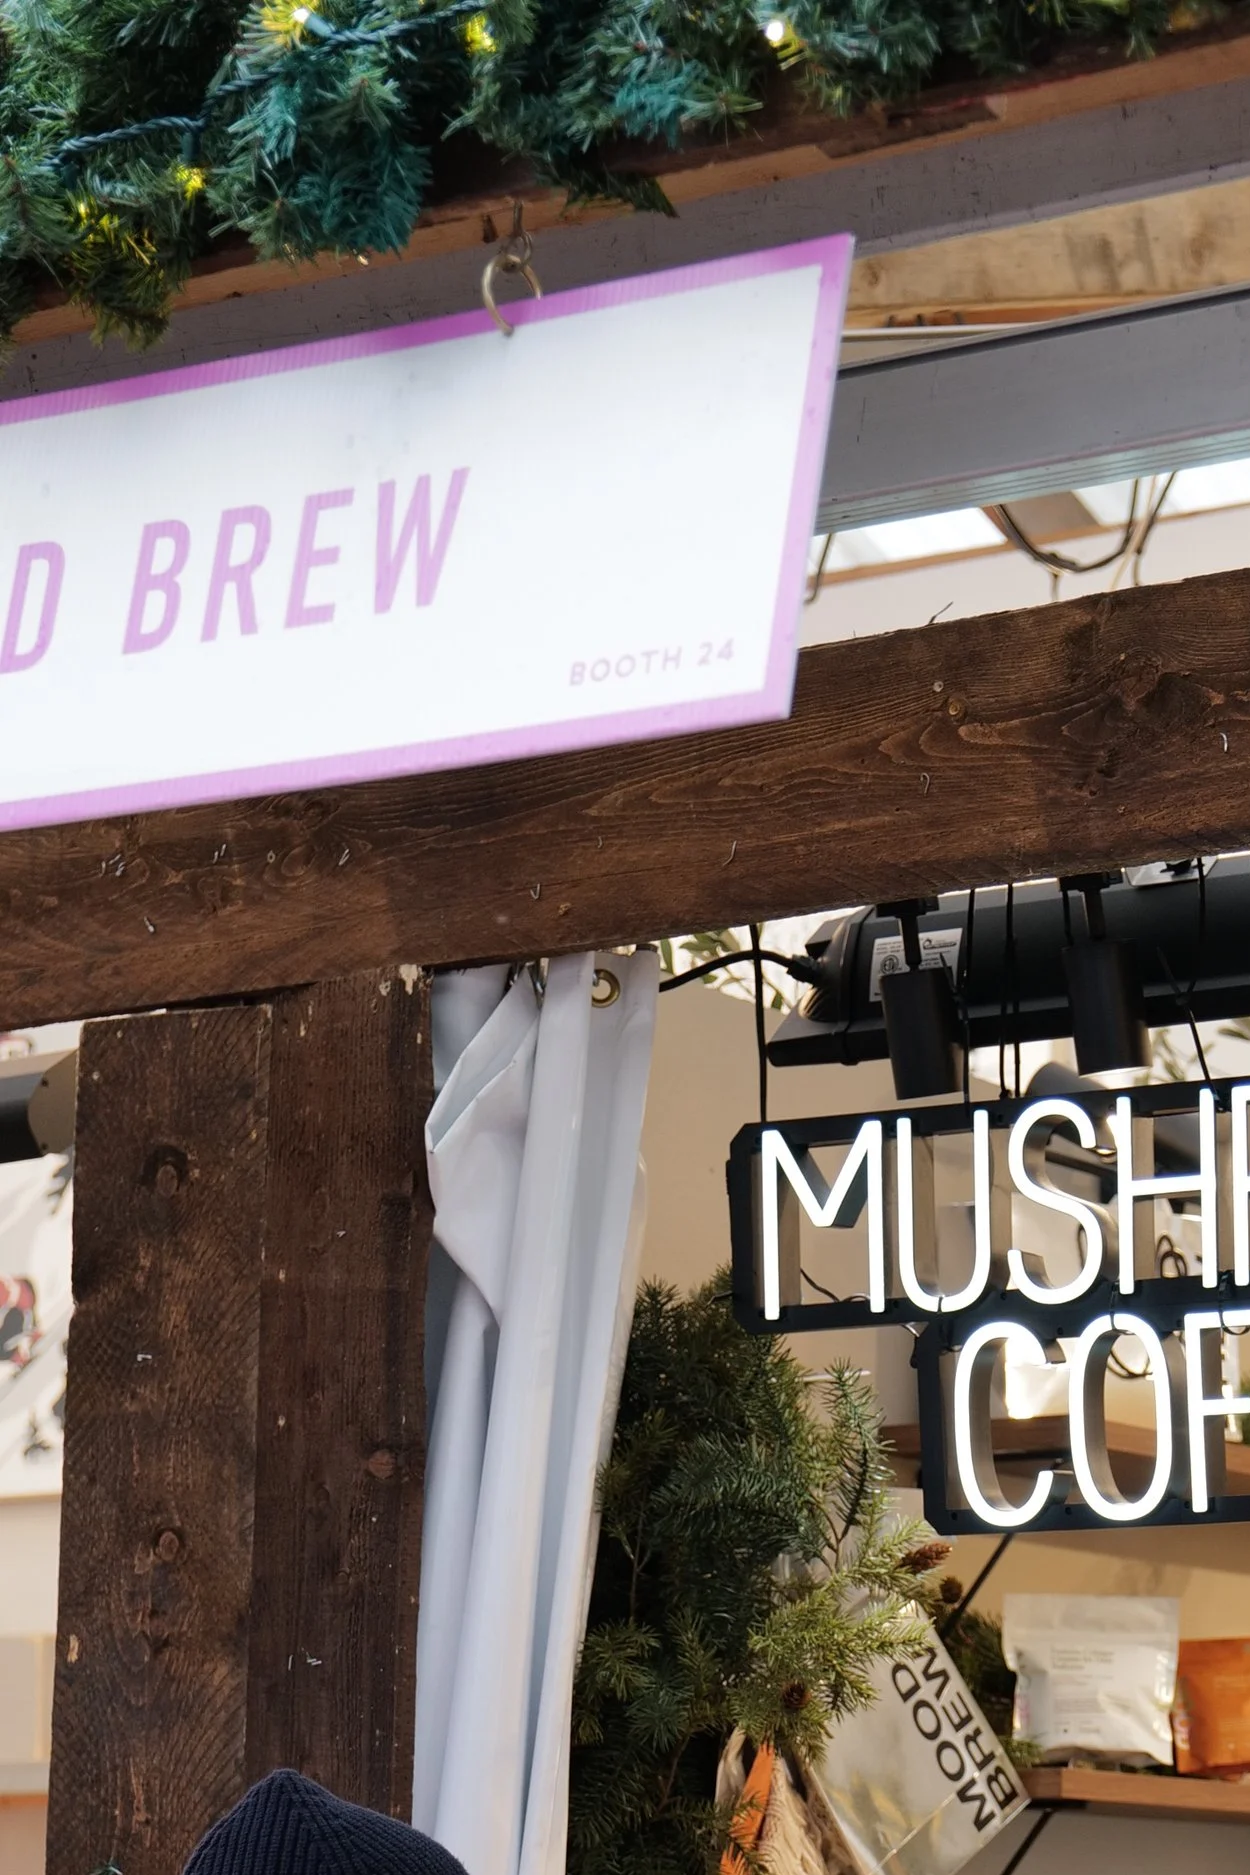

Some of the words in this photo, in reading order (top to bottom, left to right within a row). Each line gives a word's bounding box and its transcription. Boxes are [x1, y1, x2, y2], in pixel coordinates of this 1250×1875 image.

[122, 466, 470, 655] BREW
[569, 644, 682, 686] BOOTH
[697, 637, 735, 668] 24
[891, 1662, 995, 1832] MOOD
[916, 1648, 1019, 1811] BREW
